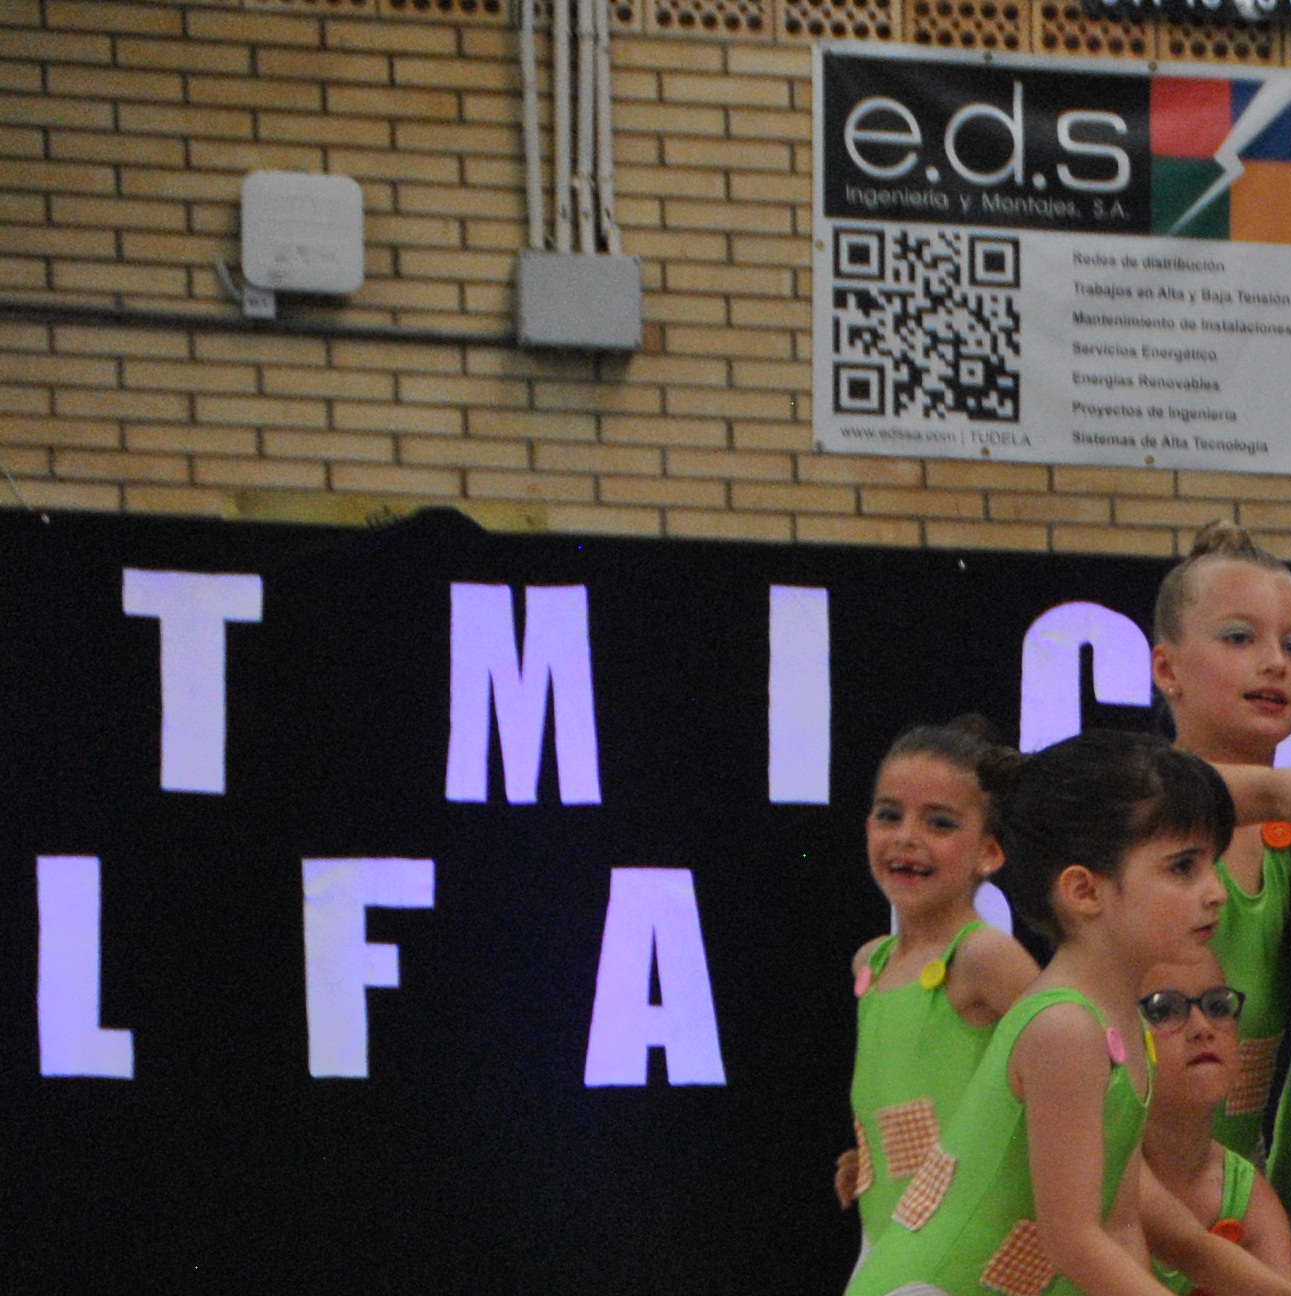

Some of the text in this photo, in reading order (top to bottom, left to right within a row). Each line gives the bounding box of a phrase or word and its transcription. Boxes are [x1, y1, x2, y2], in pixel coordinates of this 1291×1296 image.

[843, 78, 1132, 194] e.d.s
[1072, 251, 1117, 267] Redes
[1121, 254, 1139, 269] de
[1072, 280, 1132, 300] Trabajos
[1136, 287, 1153, 299] en
[1157, 285, 1185, 301] Alta
[1201, 288, 1233, 304] Baja
[1072, 311, 1175, 330] Mantenimiento
[1179, 316, 1197, 331] de
[1072, 341, 1137, 358] Servicios
[1139, 374, 1221, 391] Renovables
[1072, 401, 1143, 419] Proyectos
[1147, 405, 1164, 418] de
[970, 431, 1033, 448] TUDELA
[1072, 430, 1136, 447] Sistemas
[1140, 433, 1158, 449] de
[1161, 436, 1189, 450] Alta
